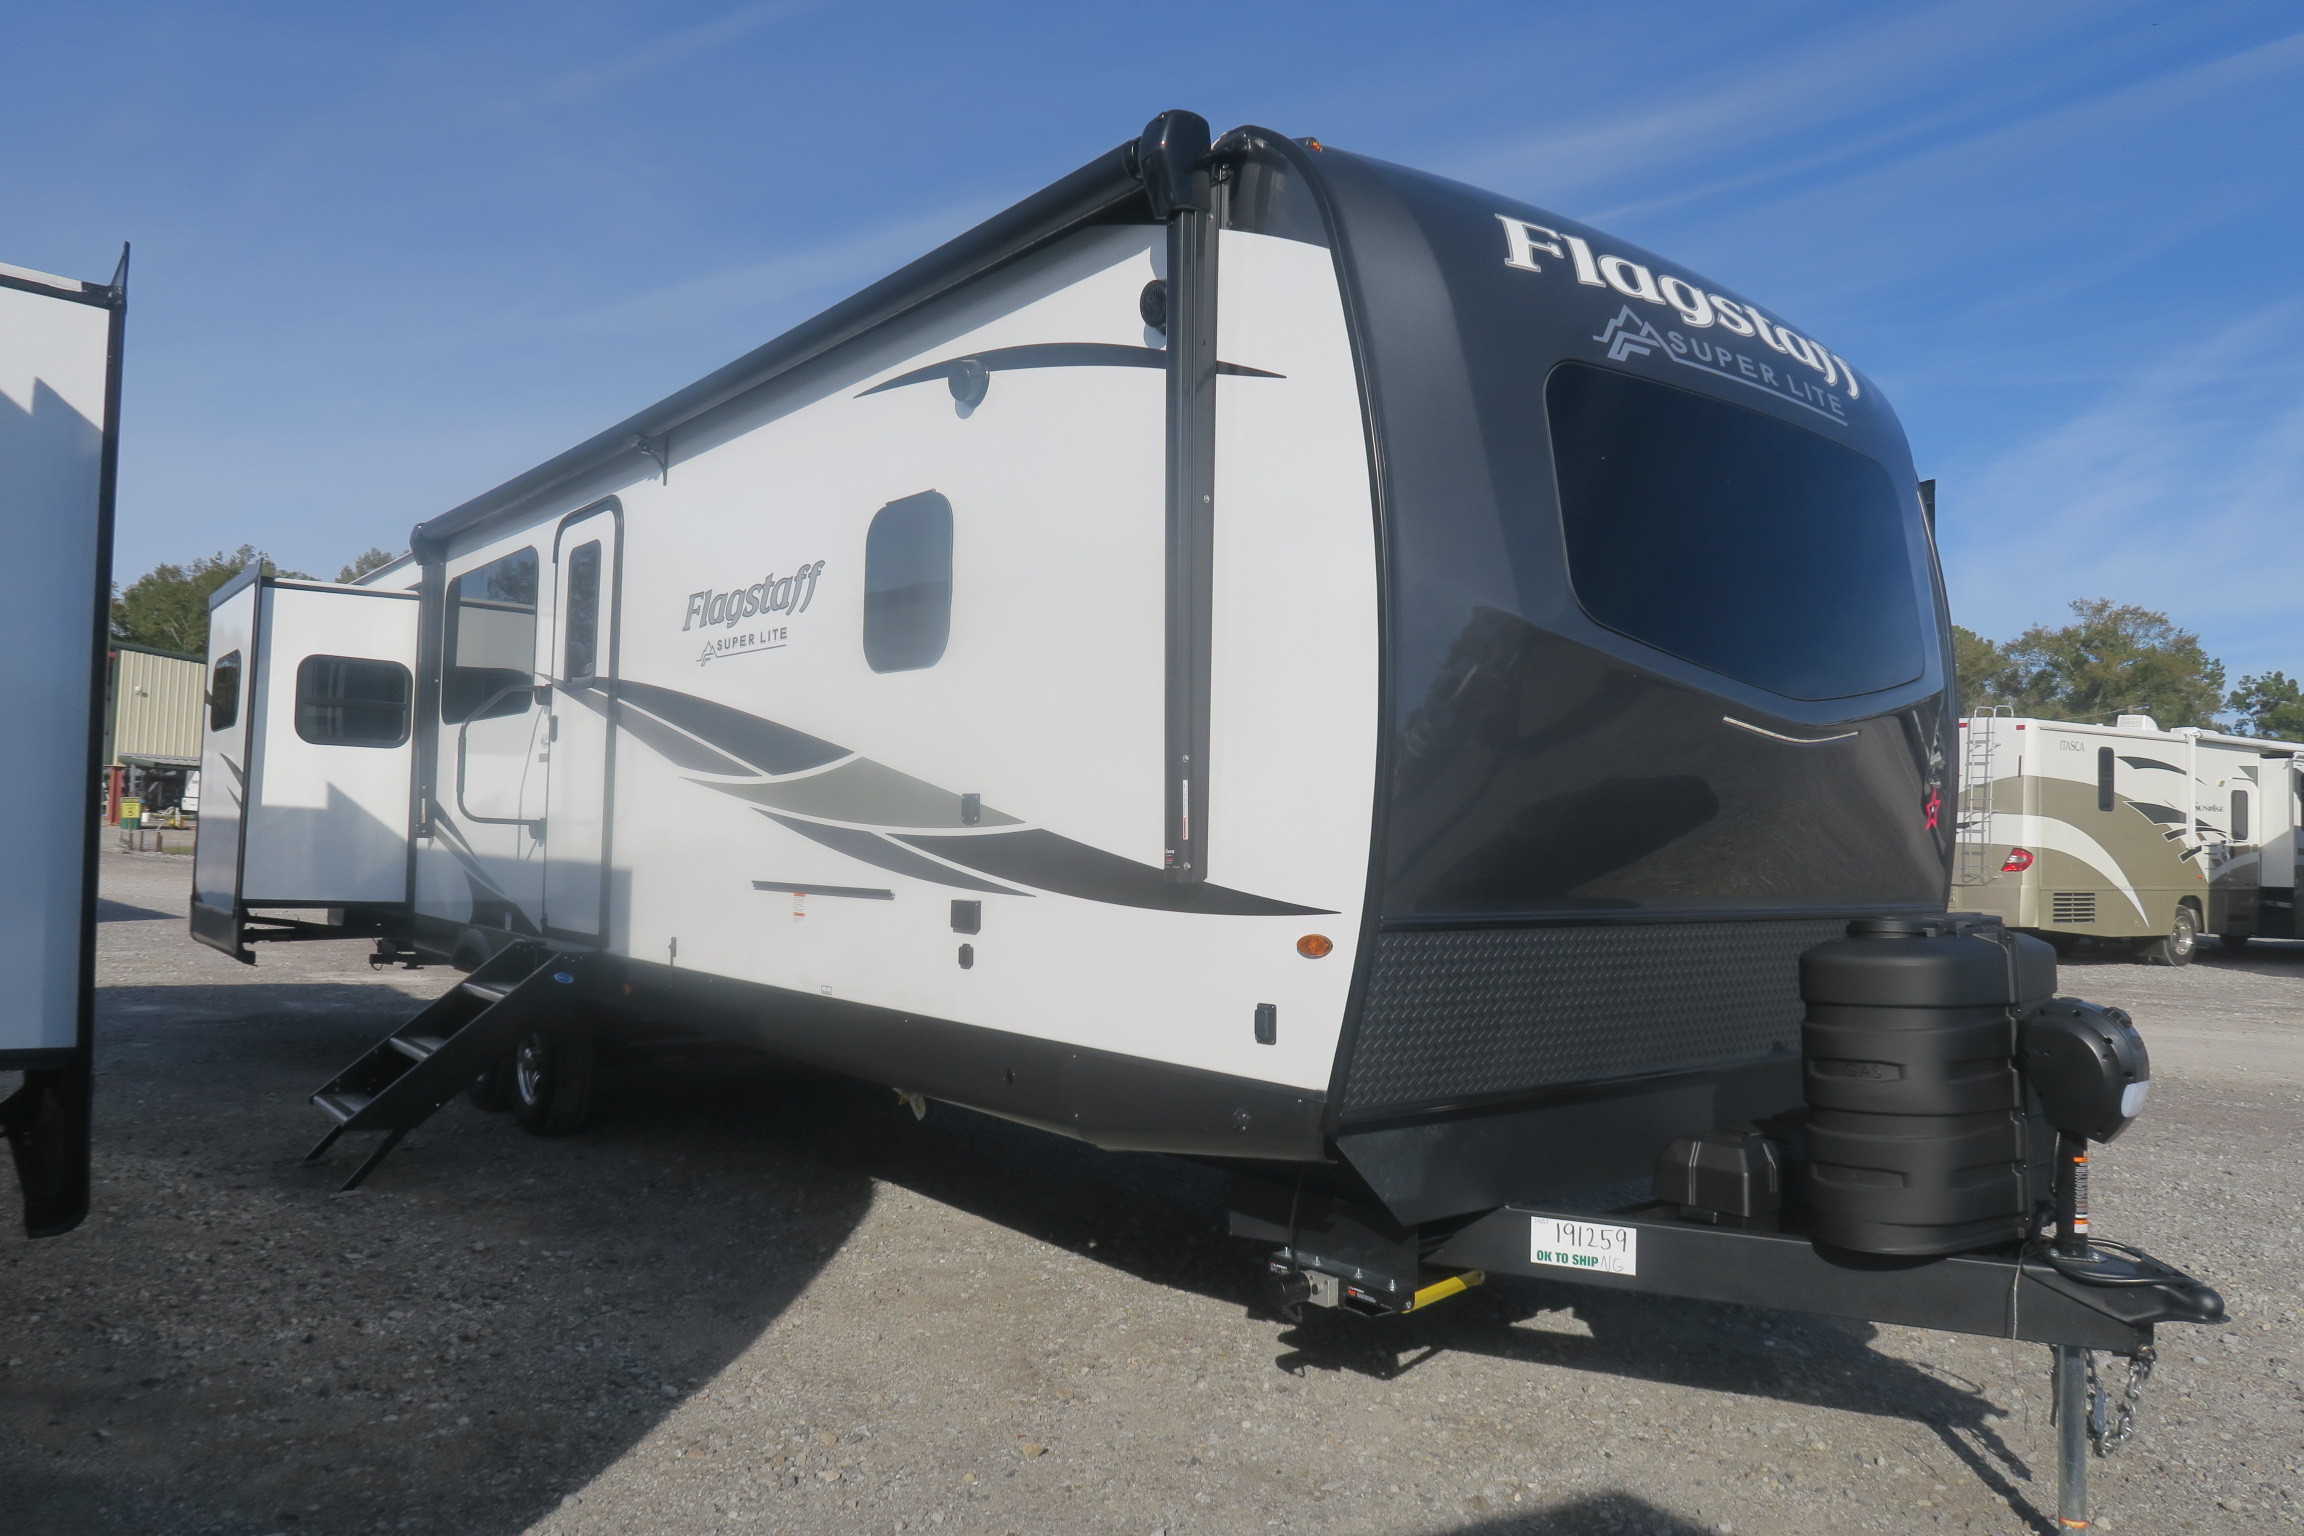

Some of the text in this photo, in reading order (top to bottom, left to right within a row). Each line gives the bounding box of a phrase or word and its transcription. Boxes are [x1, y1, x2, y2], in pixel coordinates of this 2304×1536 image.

[1495, 213, 1860, 399] Flagstaff
[1667, 330, 1845, 416] SUPER LITE
[682, 560, 826, 632] Flagstaff
[717, 627, 788, 650] SUPER LITE
[2060, 740, 2085, 751] ITASCA
[1843, 1063, 1882, 1079] GAS
[1556, 1222, 1627, 1252] 191259
[1537, 1250, 1599, 1267] OK TO SHIP
